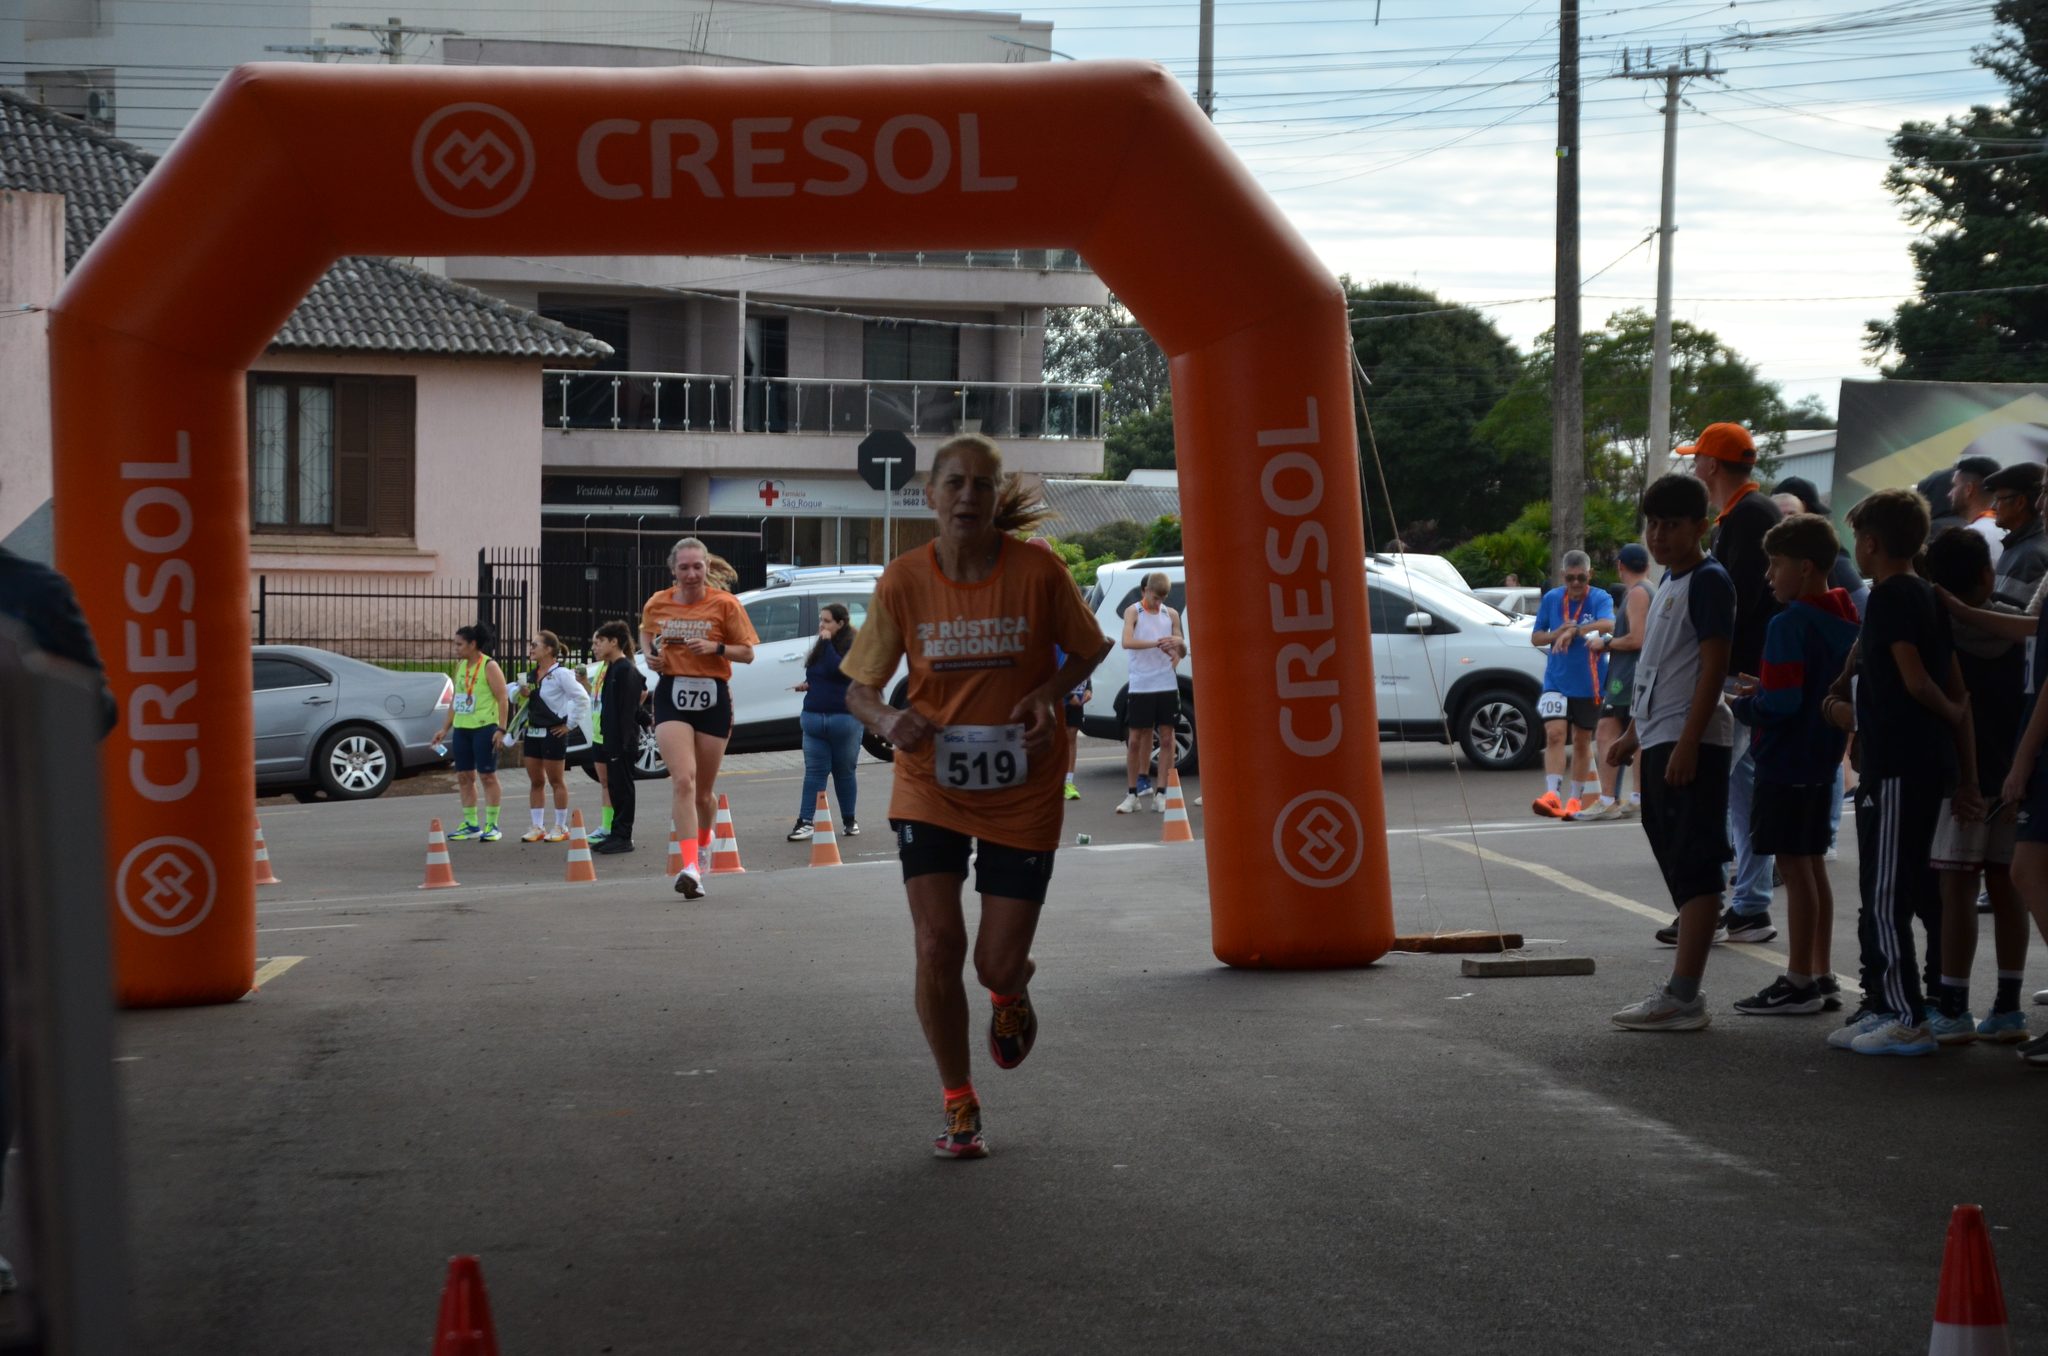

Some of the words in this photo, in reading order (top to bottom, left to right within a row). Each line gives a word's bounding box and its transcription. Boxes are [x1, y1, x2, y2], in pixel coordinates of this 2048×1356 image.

[577, 112, 1018, 200] CRESOL
[576, 484, 613, 497] Vestindo
[615, 485, 631, 497] Seu
[633, 485, 659, 497] Estilo
[798, 499, 823, 509] Roque
[1257, 396, 1343, 757] CRESOL
[120, 430, 200, 802] CRESOL
[939, 615, 1030, 638] RÚSTICA
[923, 634, 1025, 657] REGIONAL
[455, 700, 471, 713] 252
[677, 690, 711, 708] 679
[1541, 700, 1563, 714] 709
[948, 750, 1017, 786] 519
